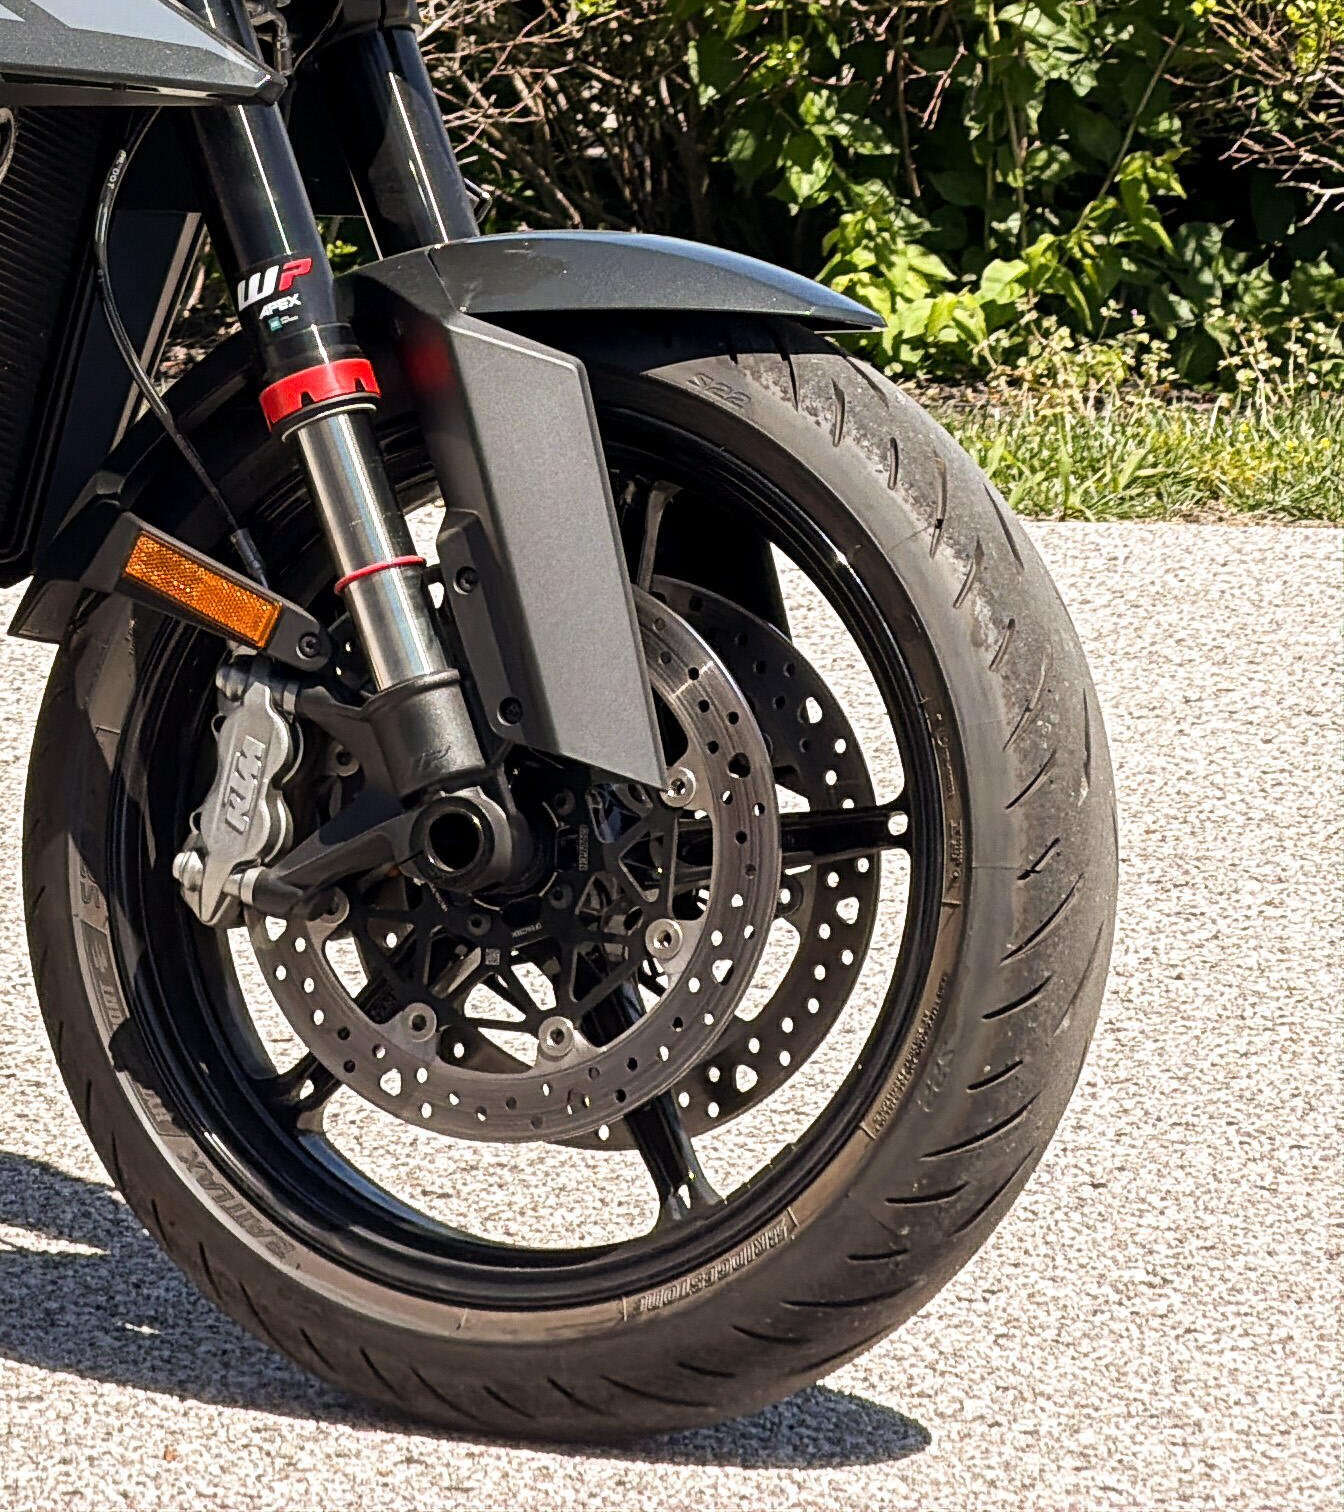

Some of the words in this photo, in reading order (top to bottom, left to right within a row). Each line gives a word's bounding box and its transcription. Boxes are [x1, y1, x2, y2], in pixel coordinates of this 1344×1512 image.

[237, 257, 313, 312] WP
[258, 292, 302, 320] APEX
[224, 734, 268, 835] KTM
